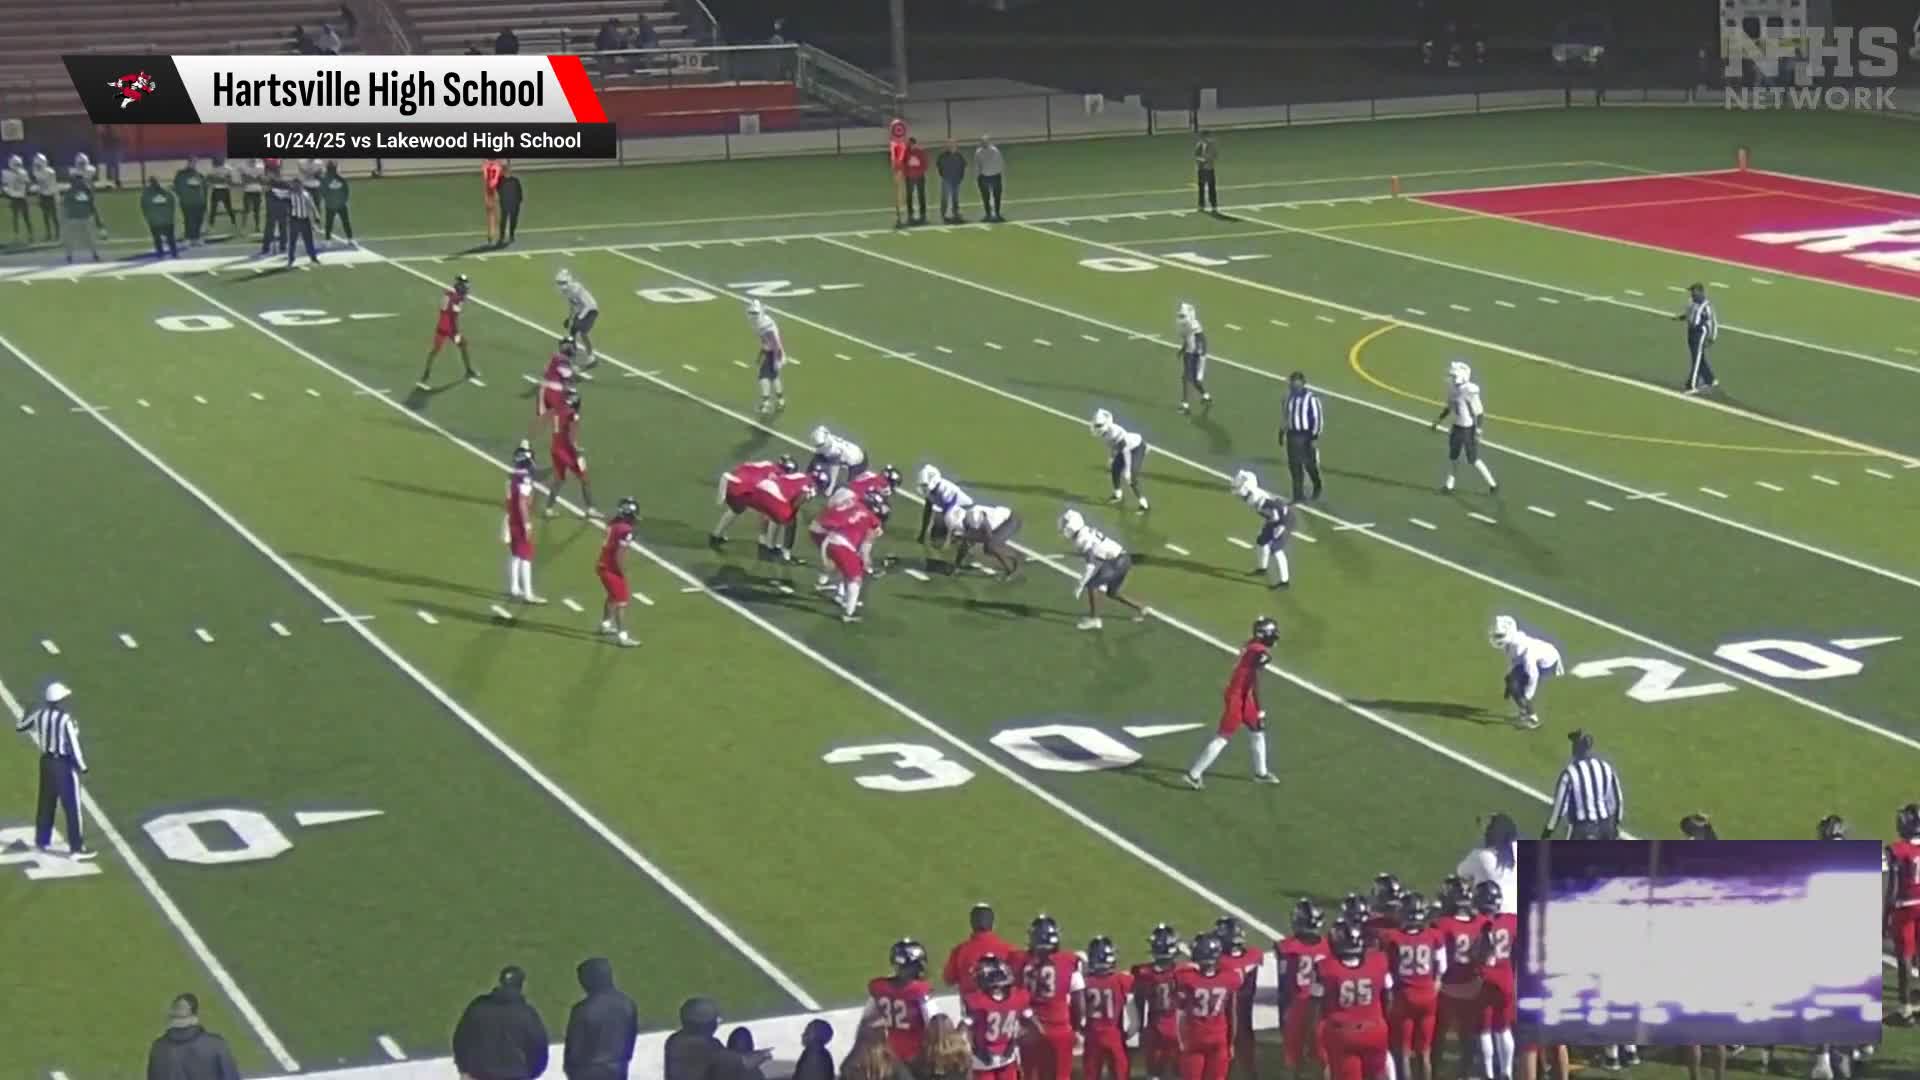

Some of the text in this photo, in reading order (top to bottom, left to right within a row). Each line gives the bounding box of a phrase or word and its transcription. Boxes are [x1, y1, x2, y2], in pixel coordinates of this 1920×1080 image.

[1570, 638, 1865, 703] 20
[821, 724, 1143, 792] 30
[1399, 944, 1431, 976] 29
[1194, 987, 1228, 1018] 37
[1339, 978, 1373, 1008] 65
[985, 1010, 1019, 1042] 34
